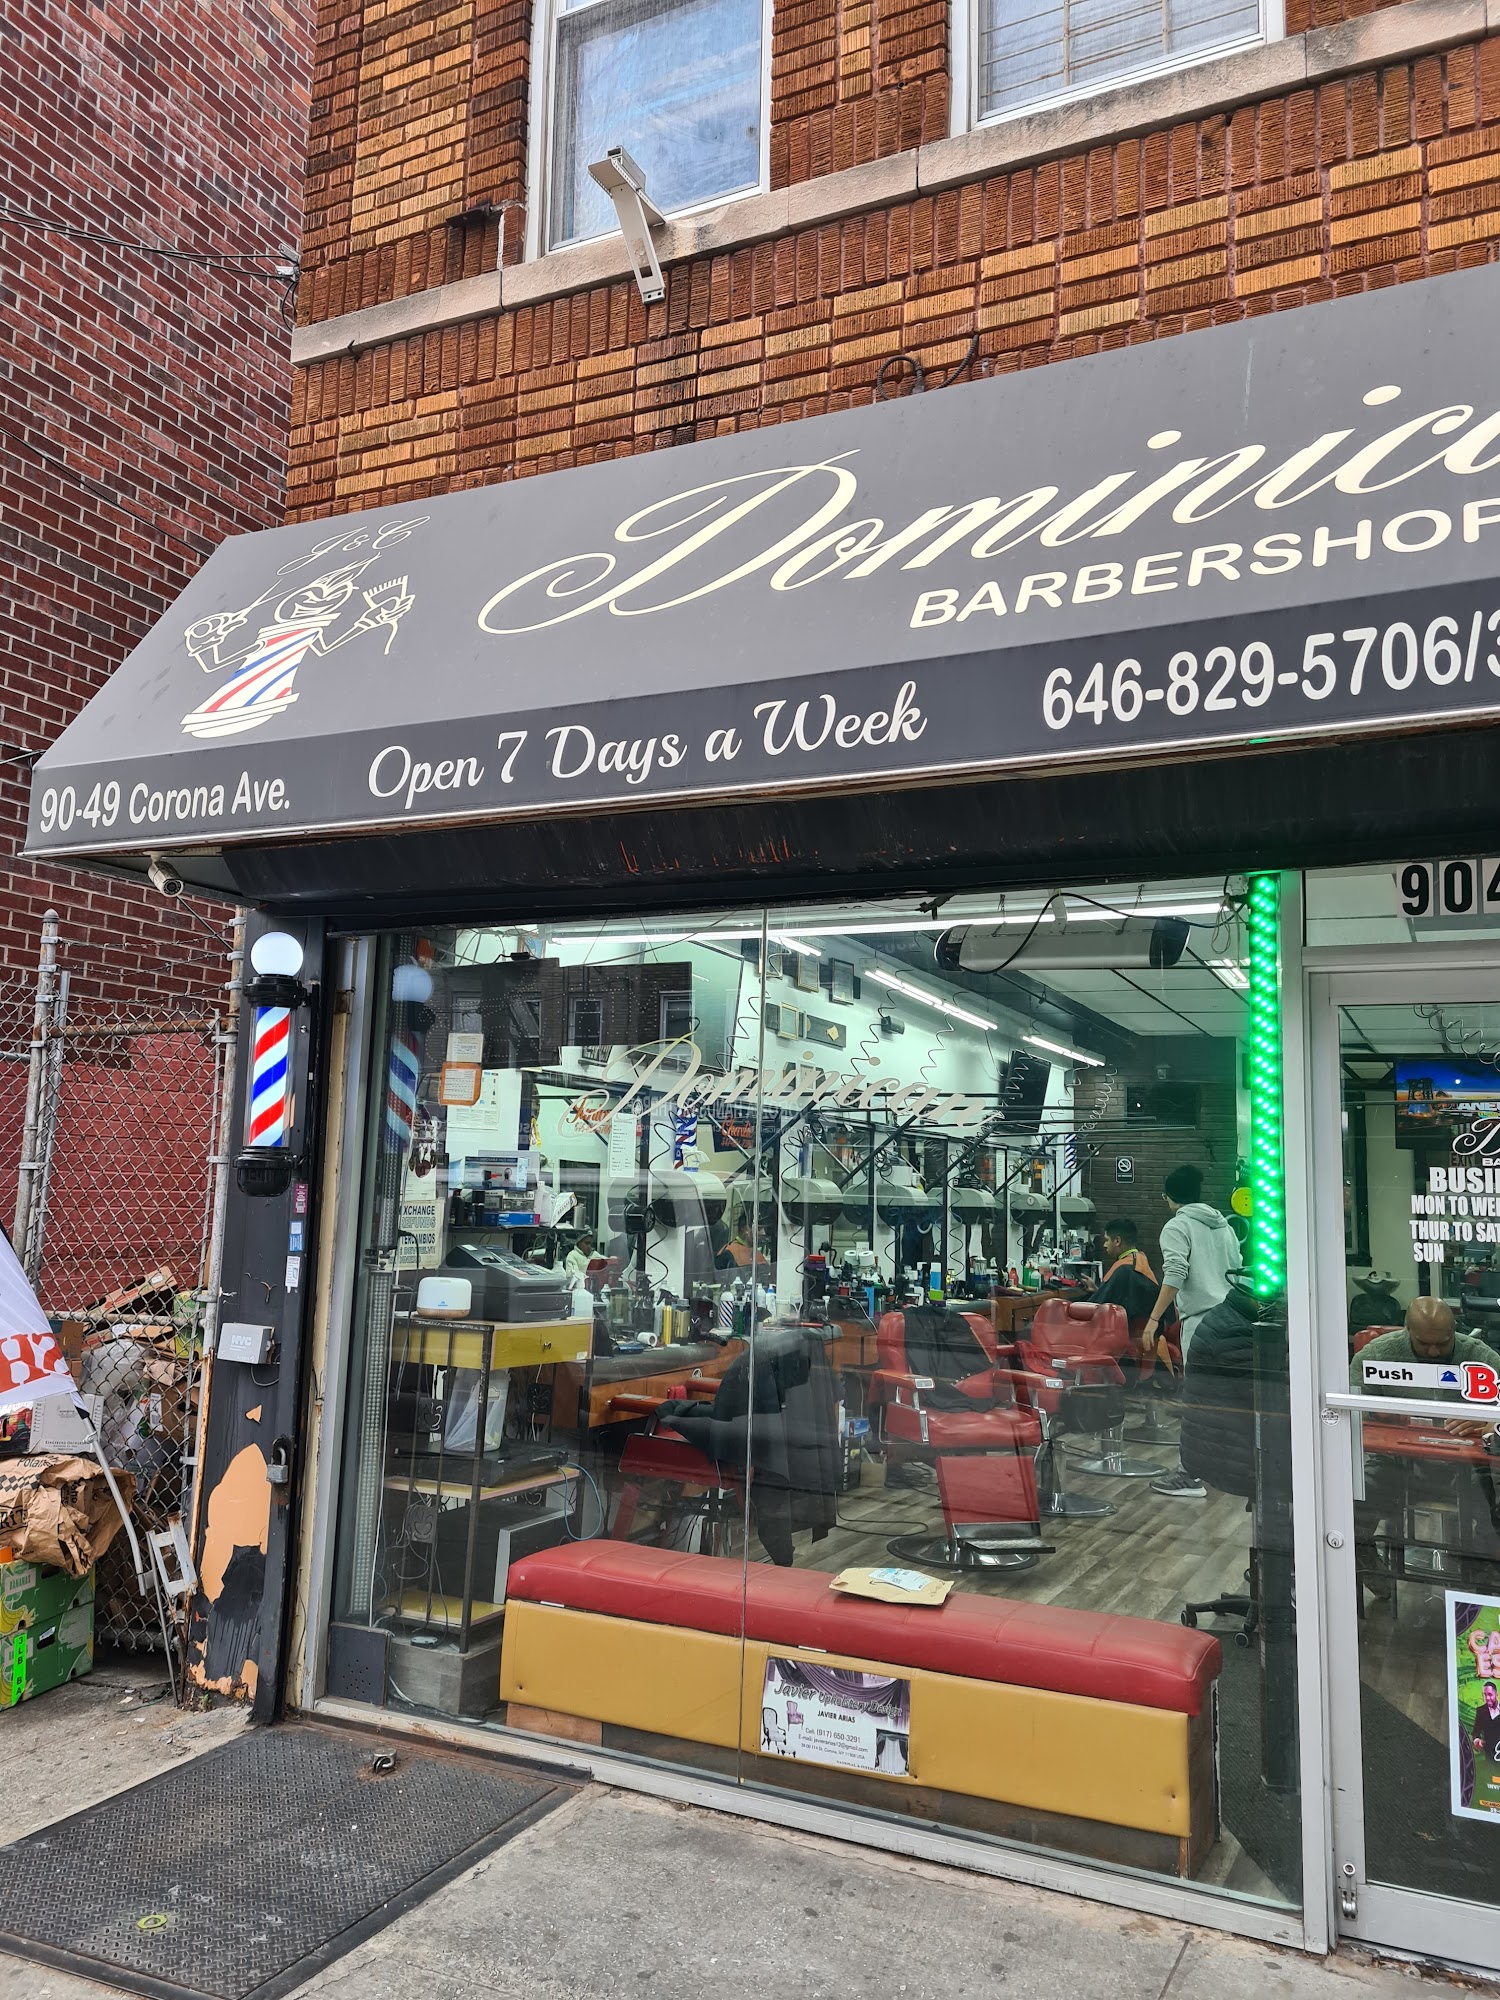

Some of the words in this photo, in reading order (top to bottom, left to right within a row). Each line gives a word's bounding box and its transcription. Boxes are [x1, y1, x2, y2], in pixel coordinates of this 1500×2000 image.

[367, 745, 485, 808] Open
[497, 730, 528, 783] 7
[544, 724, 688, 784] Days
[704, 727, 743, 763] a
[753, 680, 928, 757] Week
[39, 782, 121, 833] 90-49
[128, 781, 225, 826] Corona
[230, 770, 291, 815] Ave.
[557, 1030, 1003, 1138] Dominican
[1411, 1194, 1446, 1215] MON
[1448, 1195, 1469, 1216] TO
[1409, 1220, 1450, 1241] THUR
[1452, 1221, 1473, 1242] TO
[1413, 1241, 1445, 1263] SUN
[231, 1334, 252, 1346] NYC
[1365, 1366, 1413, 1381] Push
[774, 1679, 819, 1701] Javier
[818, 1691, 870, 1715] Upholstery
[868, 1700, 903, 1720] Design
[817, 1710, 837, 1720] JAVIER
[838, 1714, 856, 1723] ARIAS
[816, 1729, 833, 1738] (917)
[833, 1731, 861, 1744] 650-3291
